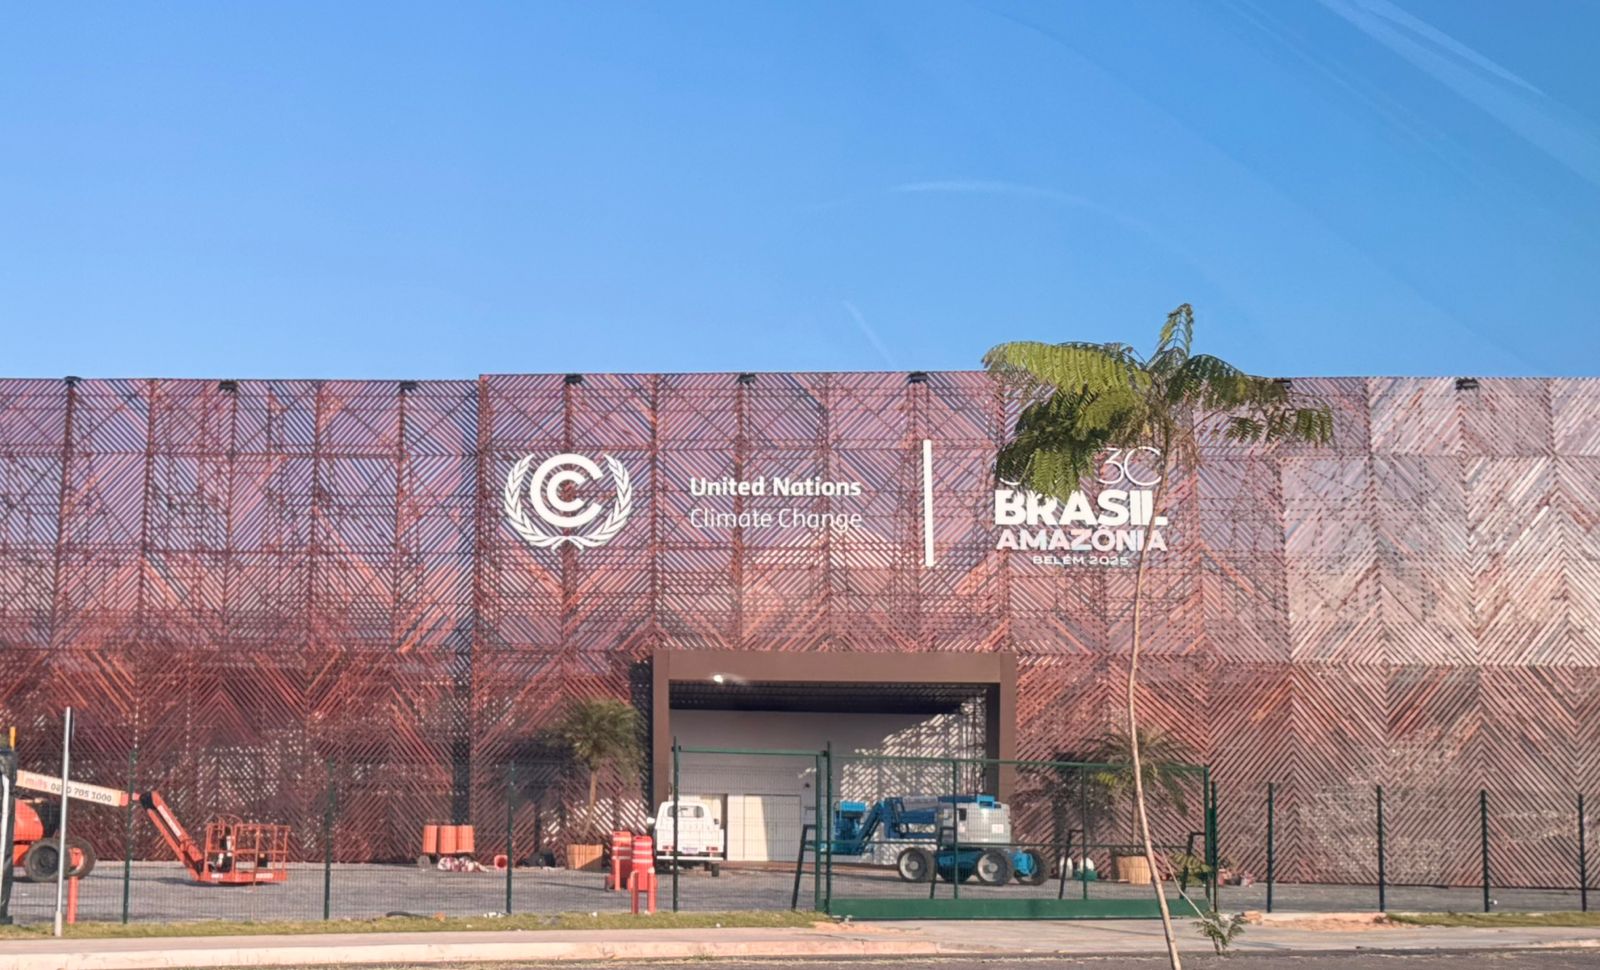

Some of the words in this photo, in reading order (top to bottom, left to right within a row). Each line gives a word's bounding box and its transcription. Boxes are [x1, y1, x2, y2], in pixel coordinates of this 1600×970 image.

[690, 476, 765, 496] United
[773, 476, 862, 496] Nations
[994, 489, 1169, 526] BRASIL
[690, 508, 772, 529] Climate
[778, 508, 862, 533] Change
[996, 526, 1168, 552] AMAZÔNIA
[1032, 554, 1085, 566] BELÉM
[1089, 555, 1130, 566] 2025
[51, 783, 72, 795] 080
